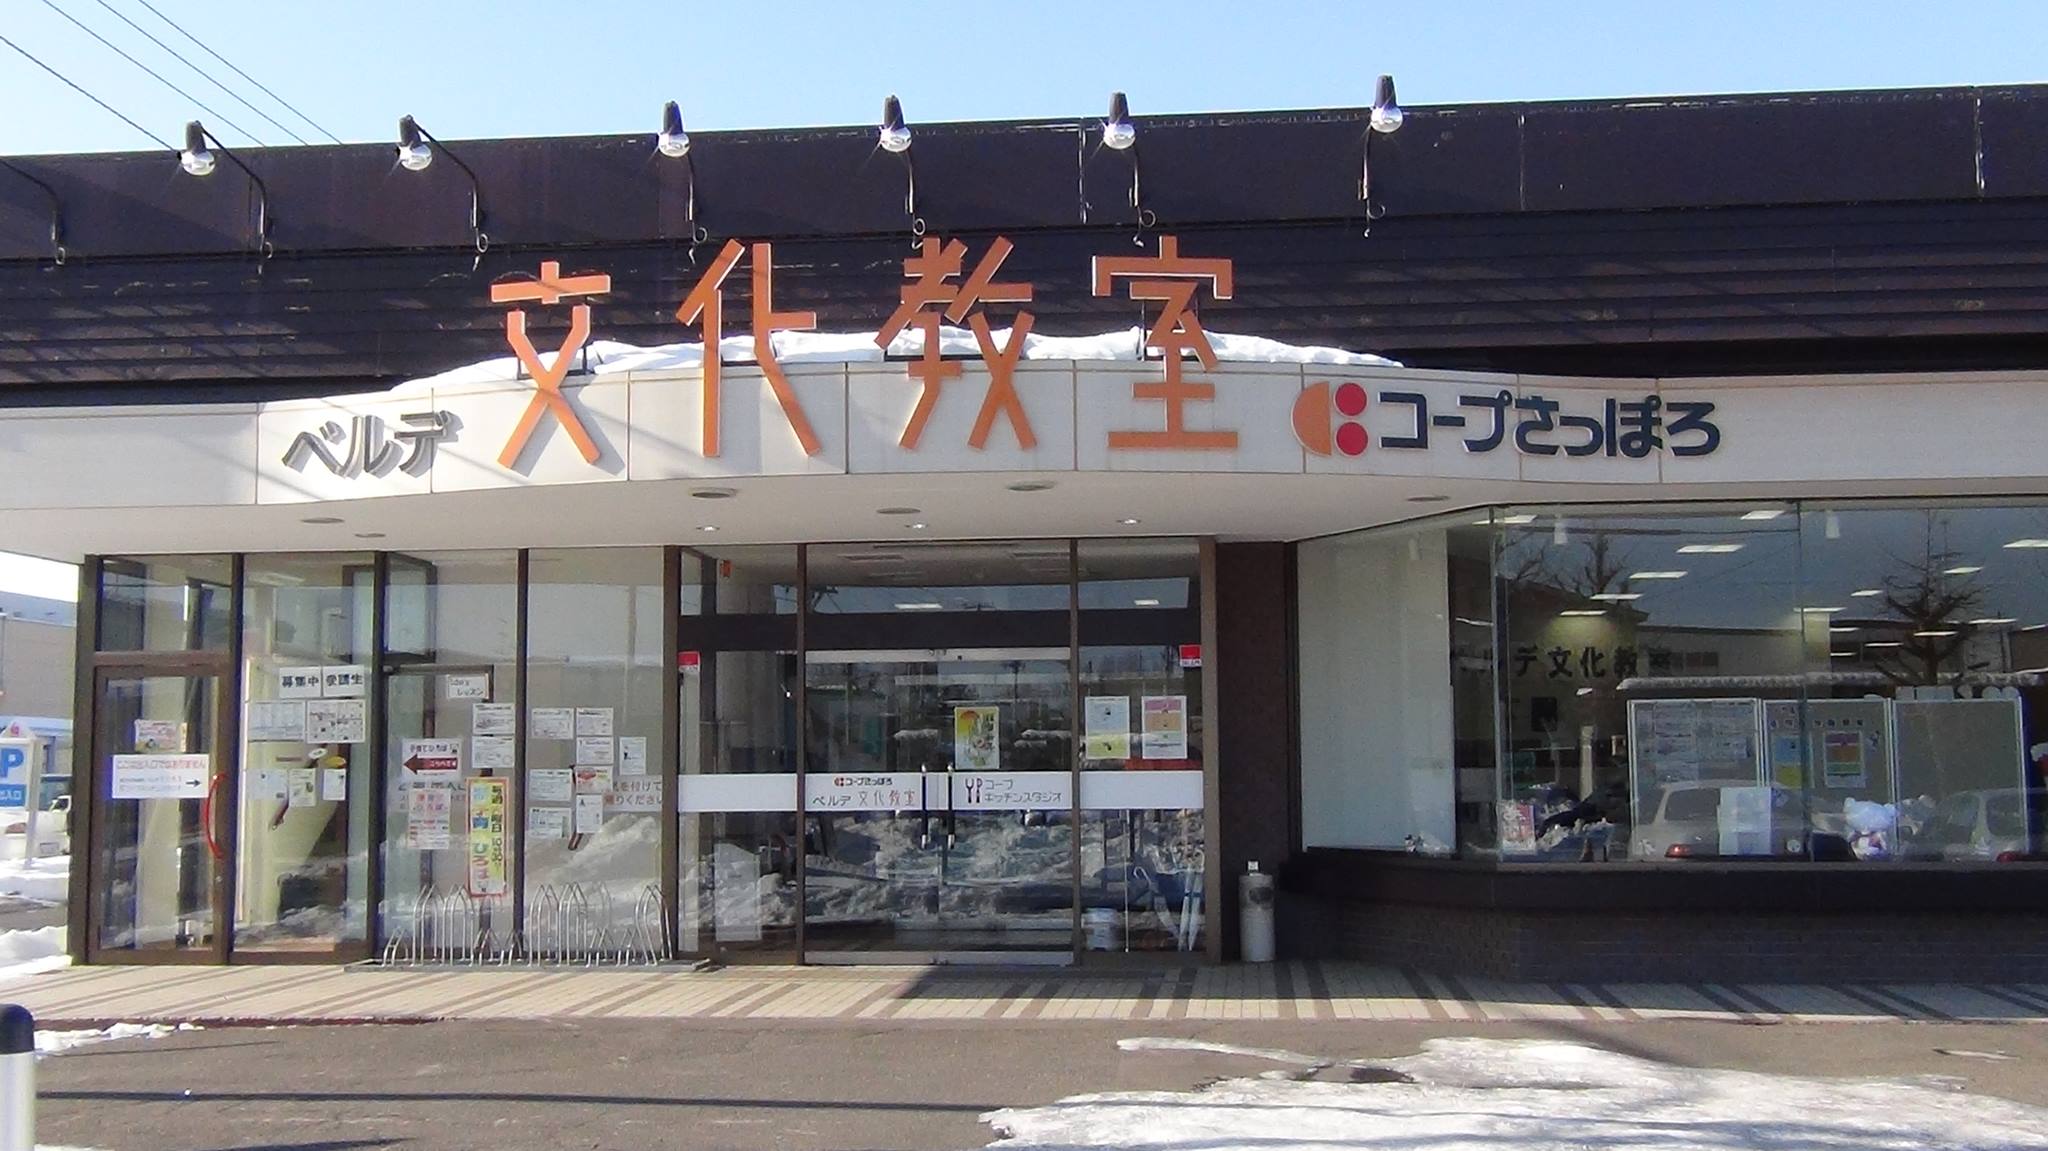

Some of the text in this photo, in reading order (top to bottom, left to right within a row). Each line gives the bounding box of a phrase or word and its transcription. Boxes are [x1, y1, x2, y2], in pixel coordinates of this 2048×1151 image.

[282, 236, 1238, 478] ベルデ 文化教室
[1377, 390, 1721, 458] コープさっぽろ
[0, 748, 24, 778] P
[859, 789, 916, 807] 文化教室
[985, 779, 1014, 790] コープ
